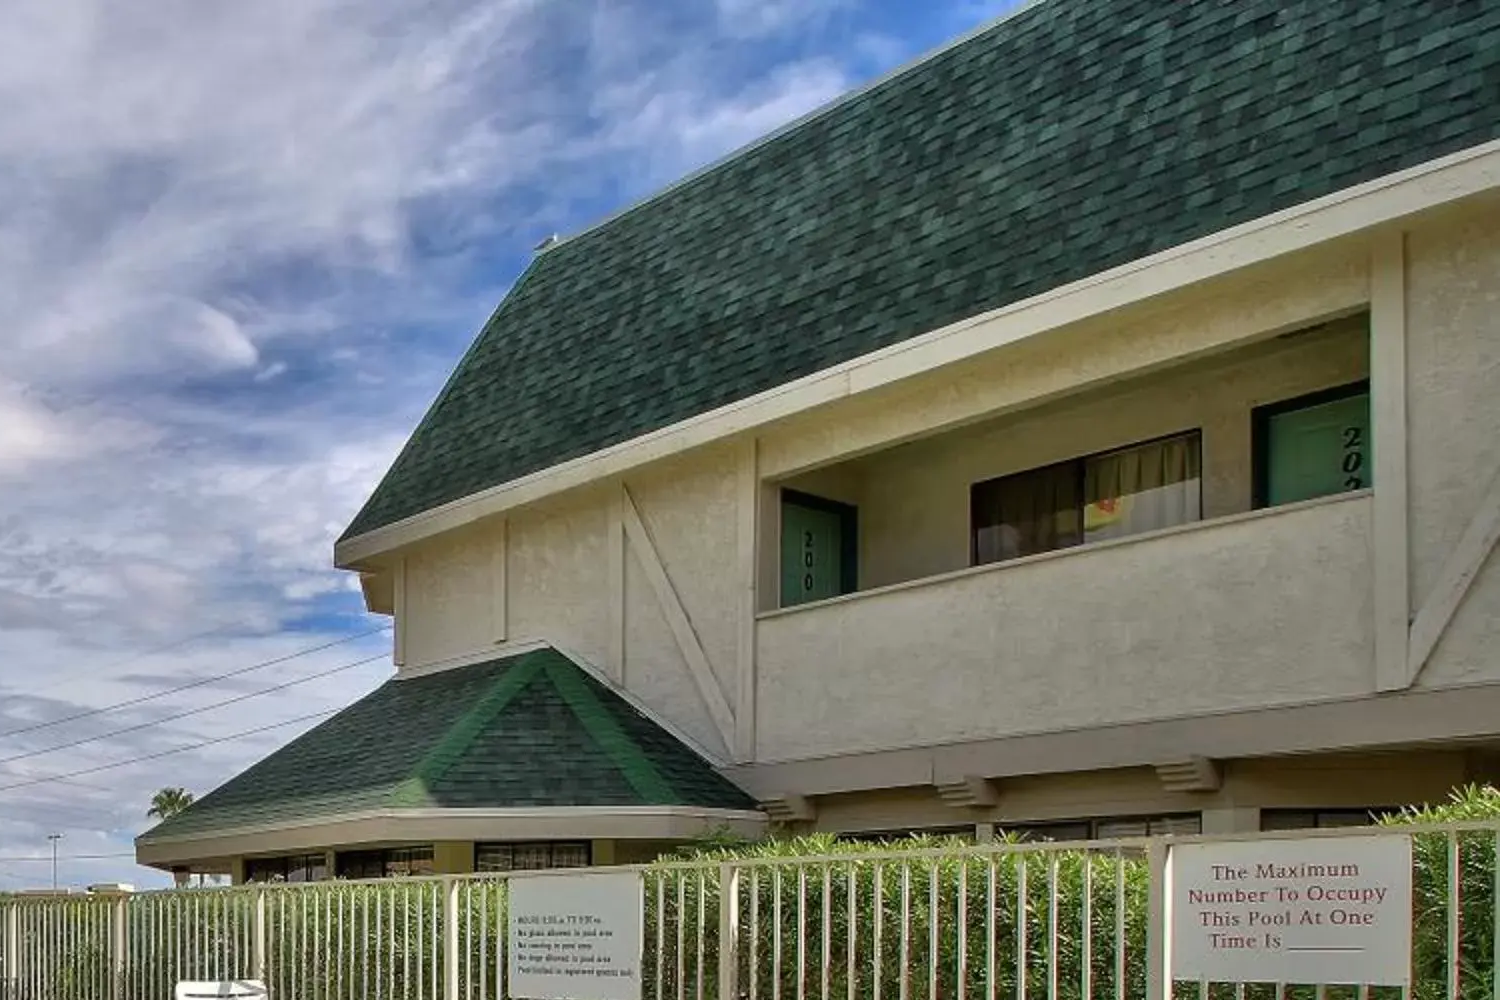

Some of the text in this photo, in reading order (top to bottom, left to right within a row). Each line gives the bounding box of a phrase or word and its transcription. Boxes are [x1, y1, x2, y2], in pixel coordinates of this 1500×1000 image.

[804, 531, 813, 591] 200
[1211, 863, 1359, 880] The Maximum
[1188, 885, 1388, 904] Number To Occupy
[1199, 909, 1375, 927] This Pool At One
[1208, 933, 1281, 949] Time Is
